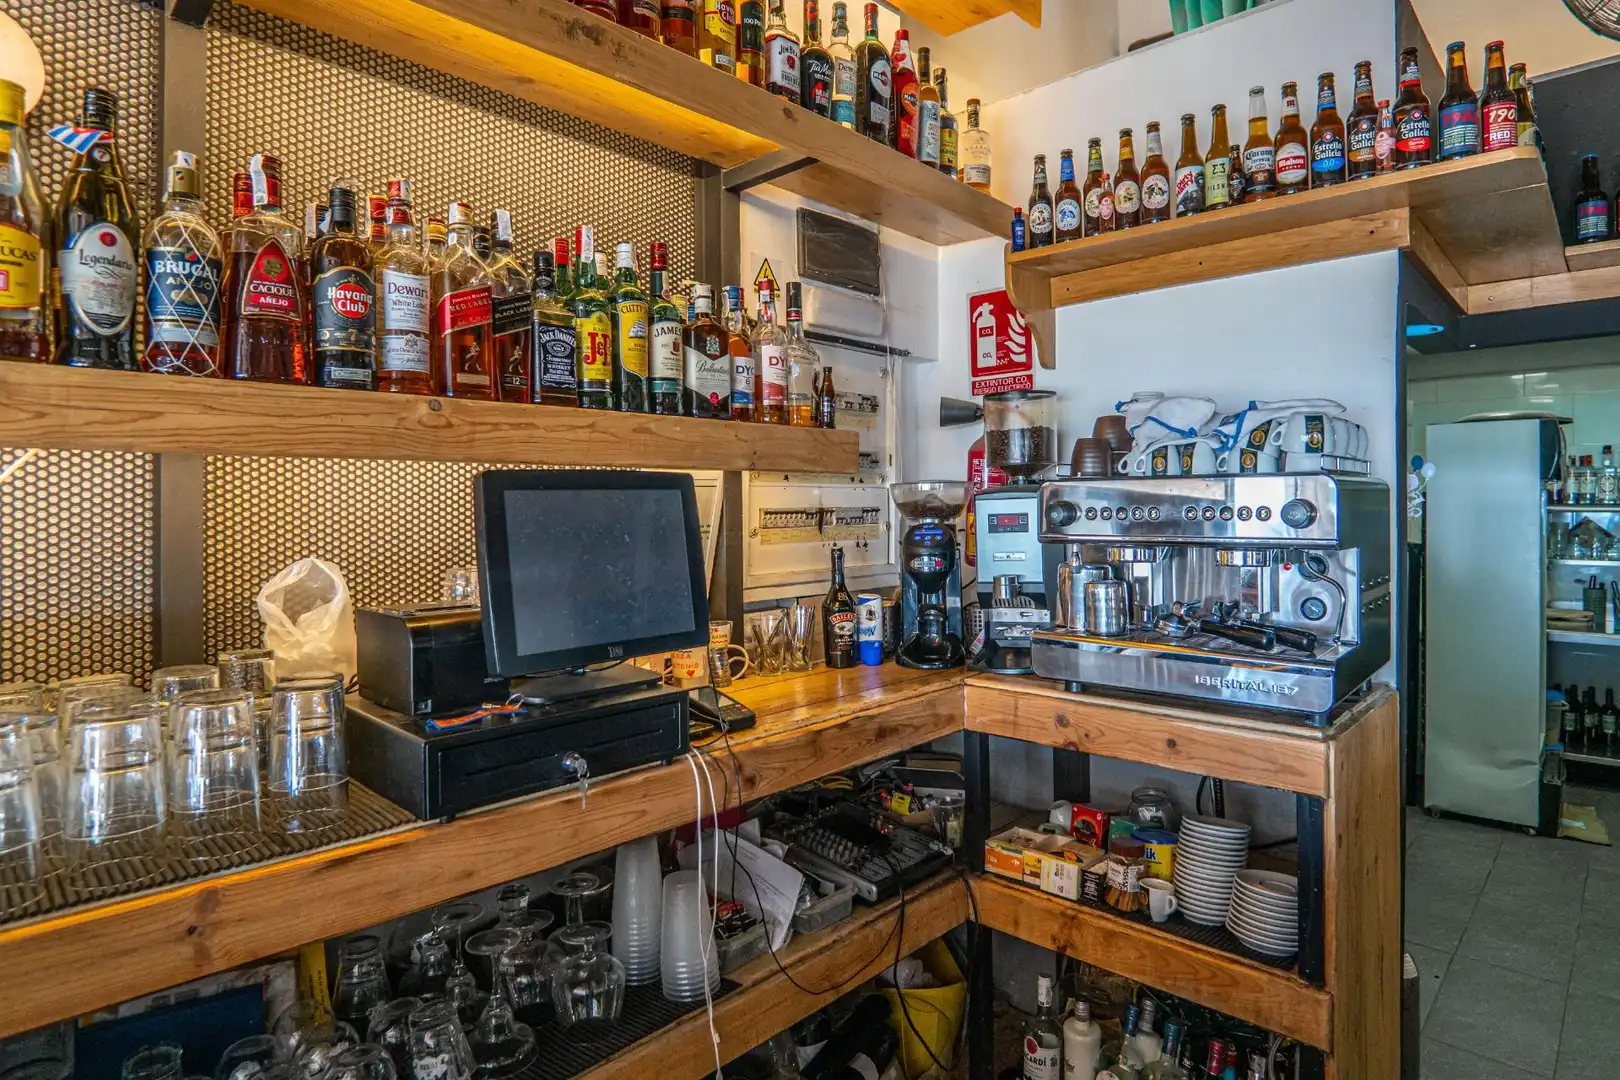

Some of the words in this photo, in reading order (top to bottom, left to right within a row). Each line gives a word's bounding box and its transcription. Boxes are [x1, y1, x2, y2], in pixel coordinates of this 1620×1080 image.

[1401, 120, 1430, 132] Estrella
[1401, 129, 1430, 139] Galicia
[1490, 131, 1510, 141] RED
[1314, 142, 1343, 153] Estrella
[1246, 149, 1274, 161] Corona
[1314, 150, 1342, 160] Galicia
[1278, 158, 1305, 168] Mahou
[79, 248, 133, 270] Legendario
[154, 259, 219, 282] BRUGAL
[250, 283, 295, 297] CACIQUE
[327, 286, 373, 304] Havana
[259, 295, 289, 307] AÑEJO
[336, 299, 366, 313] Club
[449, 303, 467, 312] RED
[468, 297, 492, 308] LABEL
[494, 310, 514, 319] BLACK
[540, 332, 555, 344] JACK
[512, 377, 521, 385] 12
[976, 378, 1013, 388] EXTINTOR
[974, 387, 996, 395] RIESGO
[1195, 675, 1269, 692] IBERITAL
